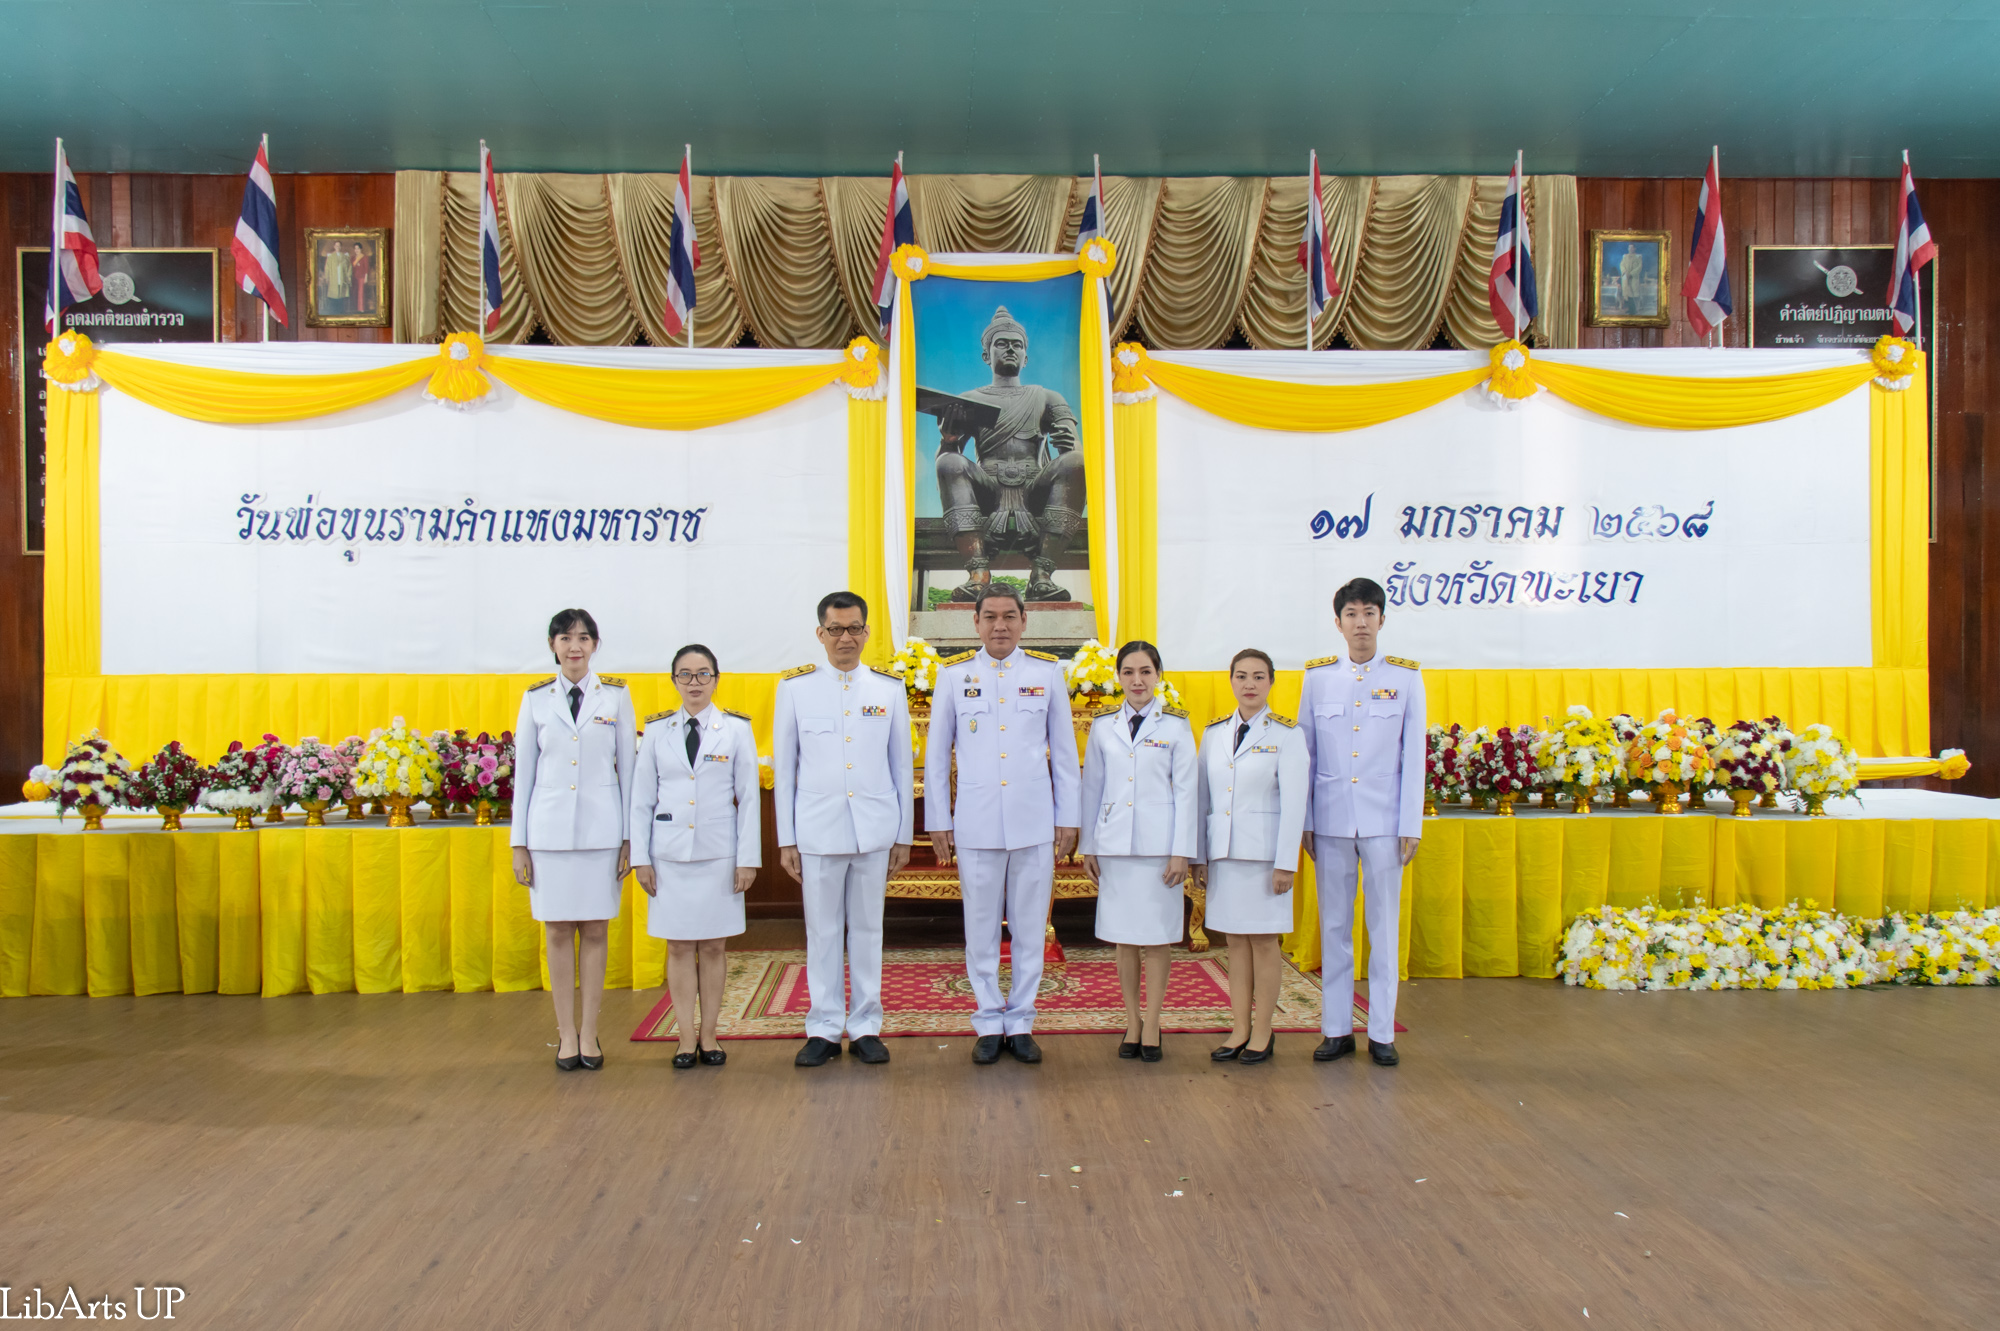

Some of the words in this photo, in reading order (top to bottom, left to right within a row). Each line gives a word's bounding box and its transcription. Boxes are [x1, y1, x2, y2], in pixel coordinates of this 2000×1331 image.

[236, 493, 707, 562] วันพ่อขุนรามคำแหงมหาราช
[1310, 492, 1375, 540] ๑๗
[1400, 503, 1566, 539] มกราคม
[1592, 499, 1716, 539] ๒๕๖๘
[1386, 560, 1646, 606] จังหวัดพะเยา
